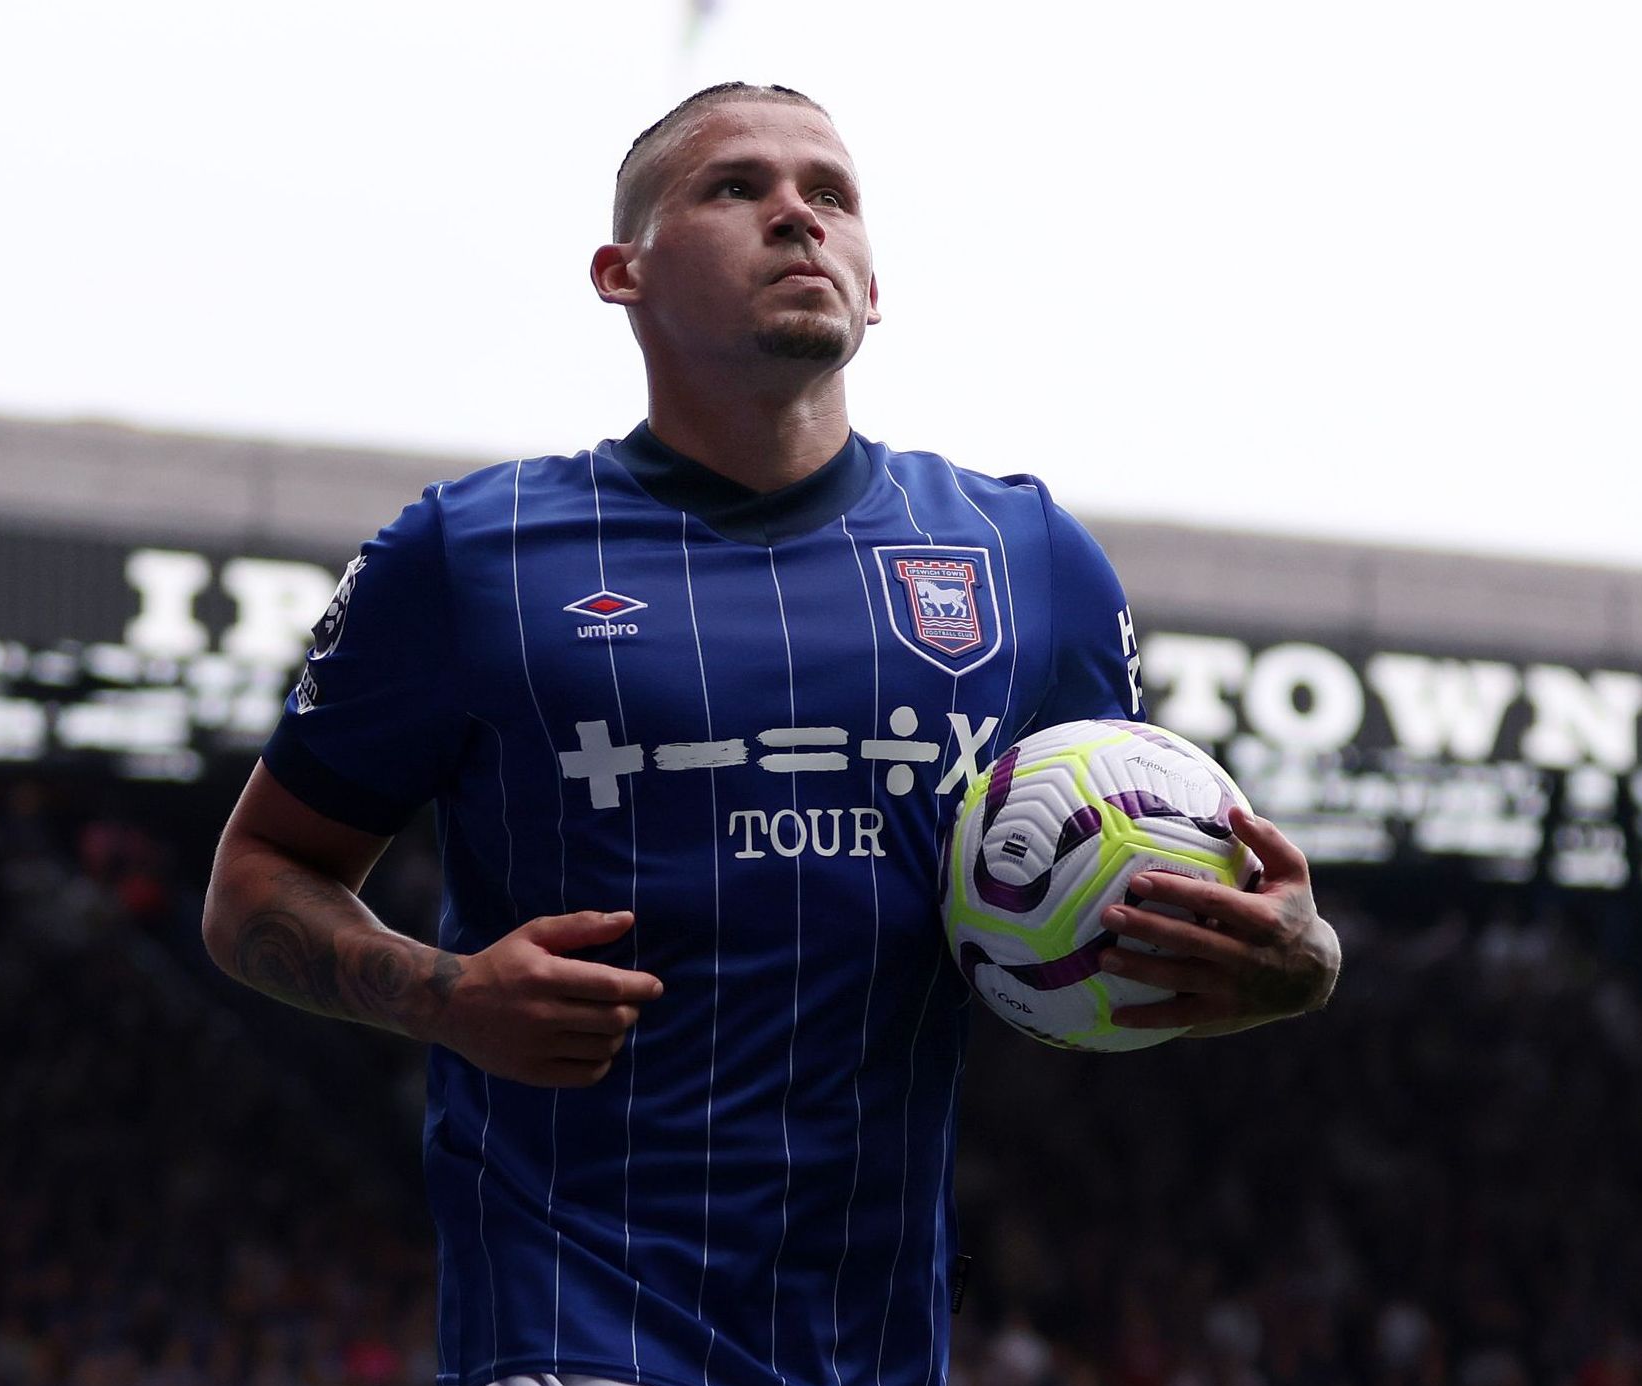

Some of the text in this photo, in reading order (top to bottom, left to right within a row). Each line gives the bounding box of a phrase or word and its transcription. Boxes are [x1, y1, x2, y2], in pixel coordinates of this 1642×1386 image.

[942, 570, 965, 578] TOWN
[577, 623, 638, 638] umbro
[729, 807, 886, 860] TOUR
